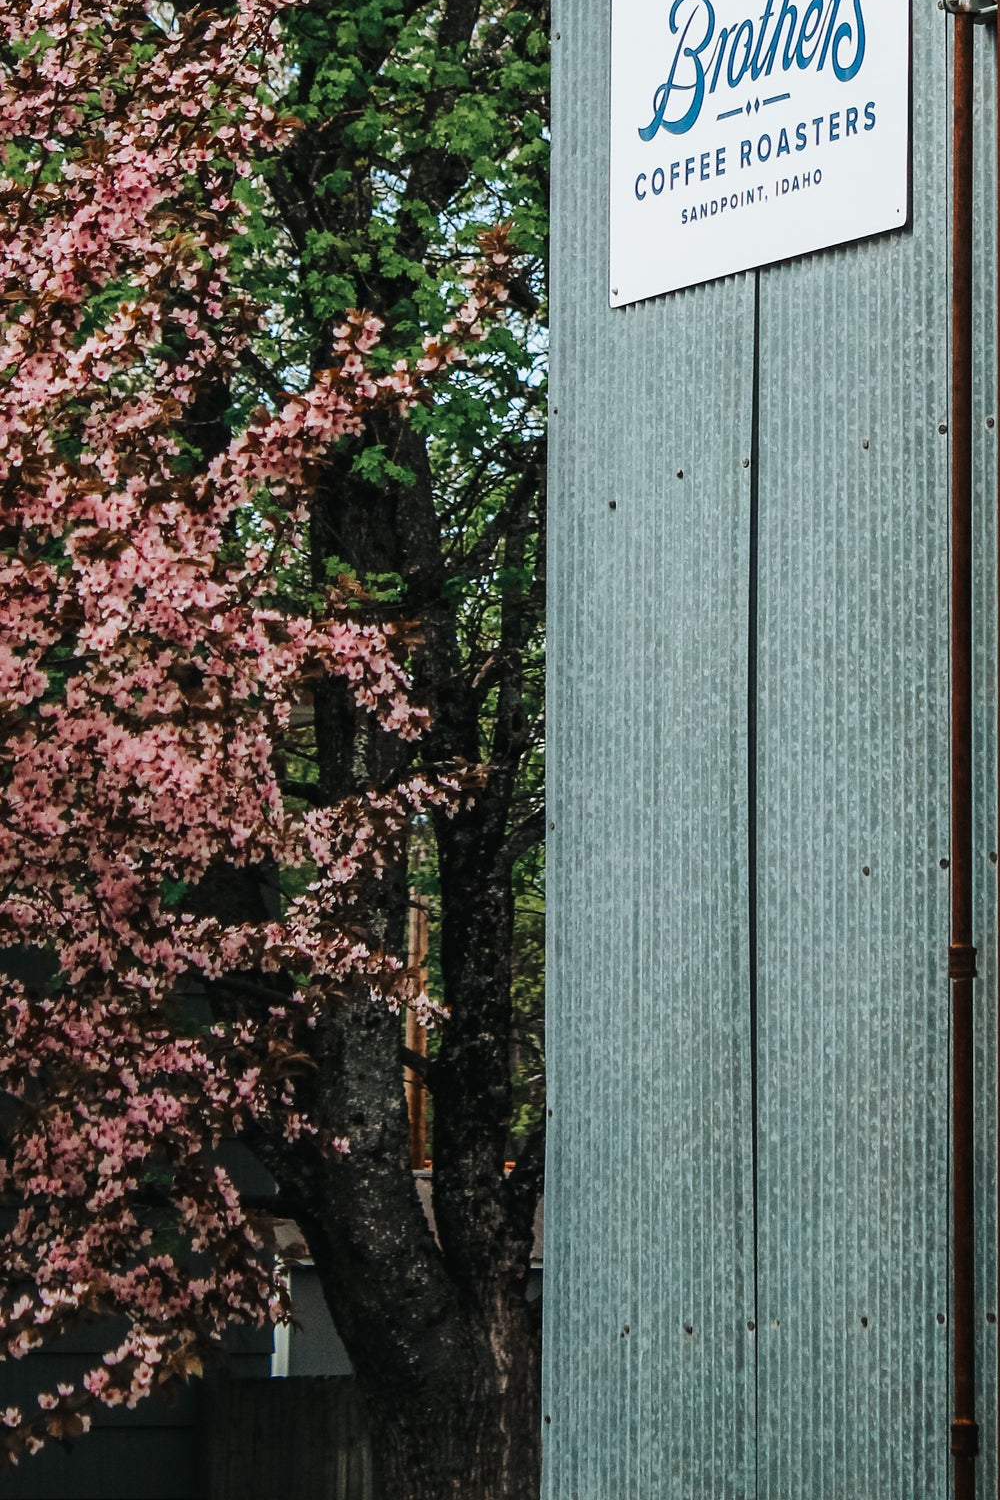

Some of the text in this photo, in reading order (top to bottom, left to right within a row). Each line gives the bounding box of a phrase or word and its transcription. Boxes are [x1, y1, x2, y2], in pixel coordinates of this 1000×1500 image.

[635, 101, 877, 201] COFFEE ROASTERS
[681, 169, 823, 225] SANDPOINT, IDAHO
